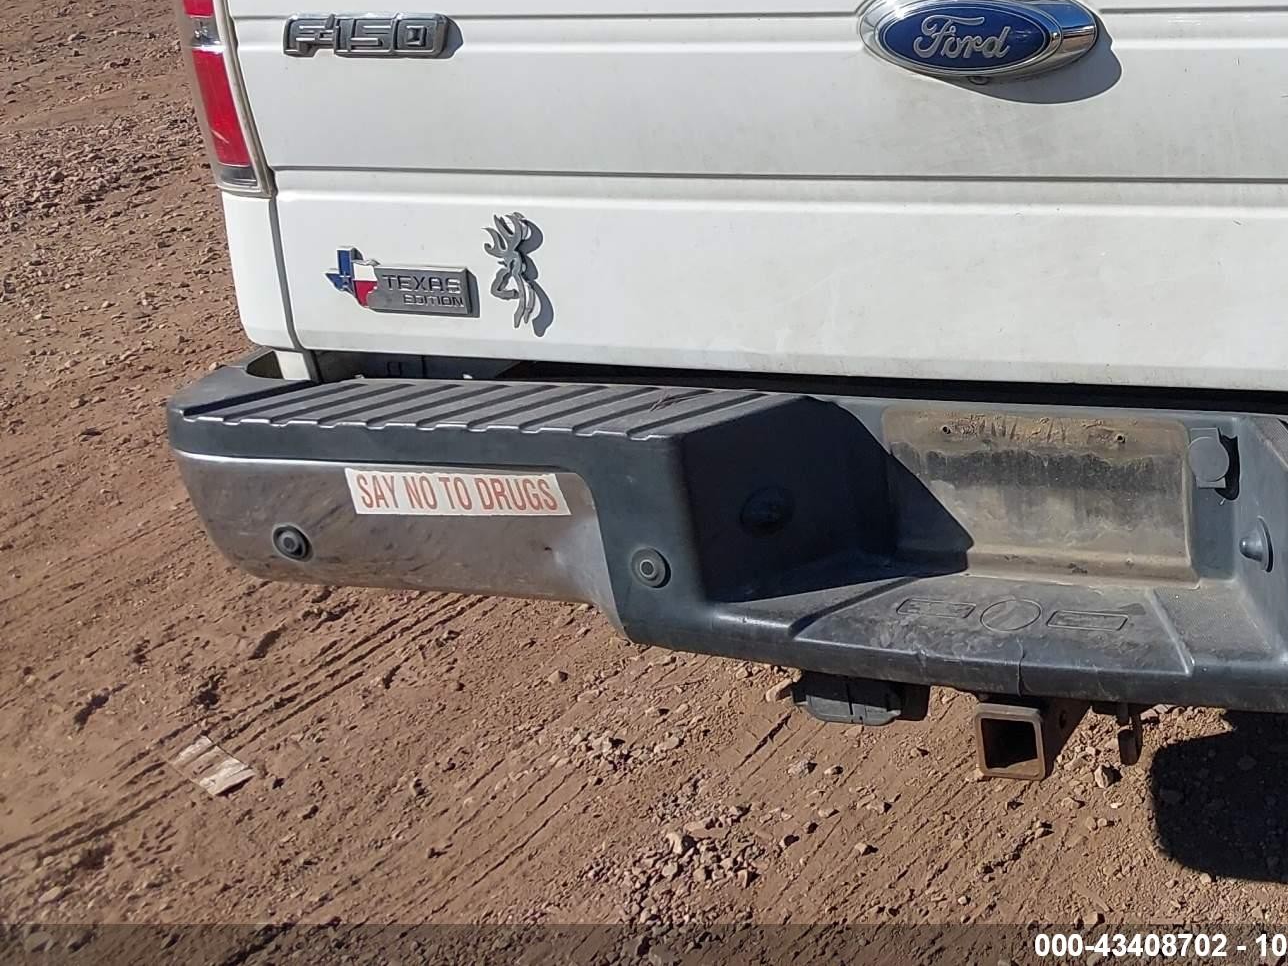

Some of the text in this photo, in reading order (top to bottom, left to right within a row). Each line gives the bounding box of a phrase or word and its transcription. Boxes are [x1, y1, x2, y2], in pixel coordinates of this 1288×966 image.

[913, 14, 1011, 59] Ford
[382, 274, 461, 294] TEXAS
[403, 294, 465, 308] EDITION
[356, 474, 558, 511] SAY NO TO DRUGS
